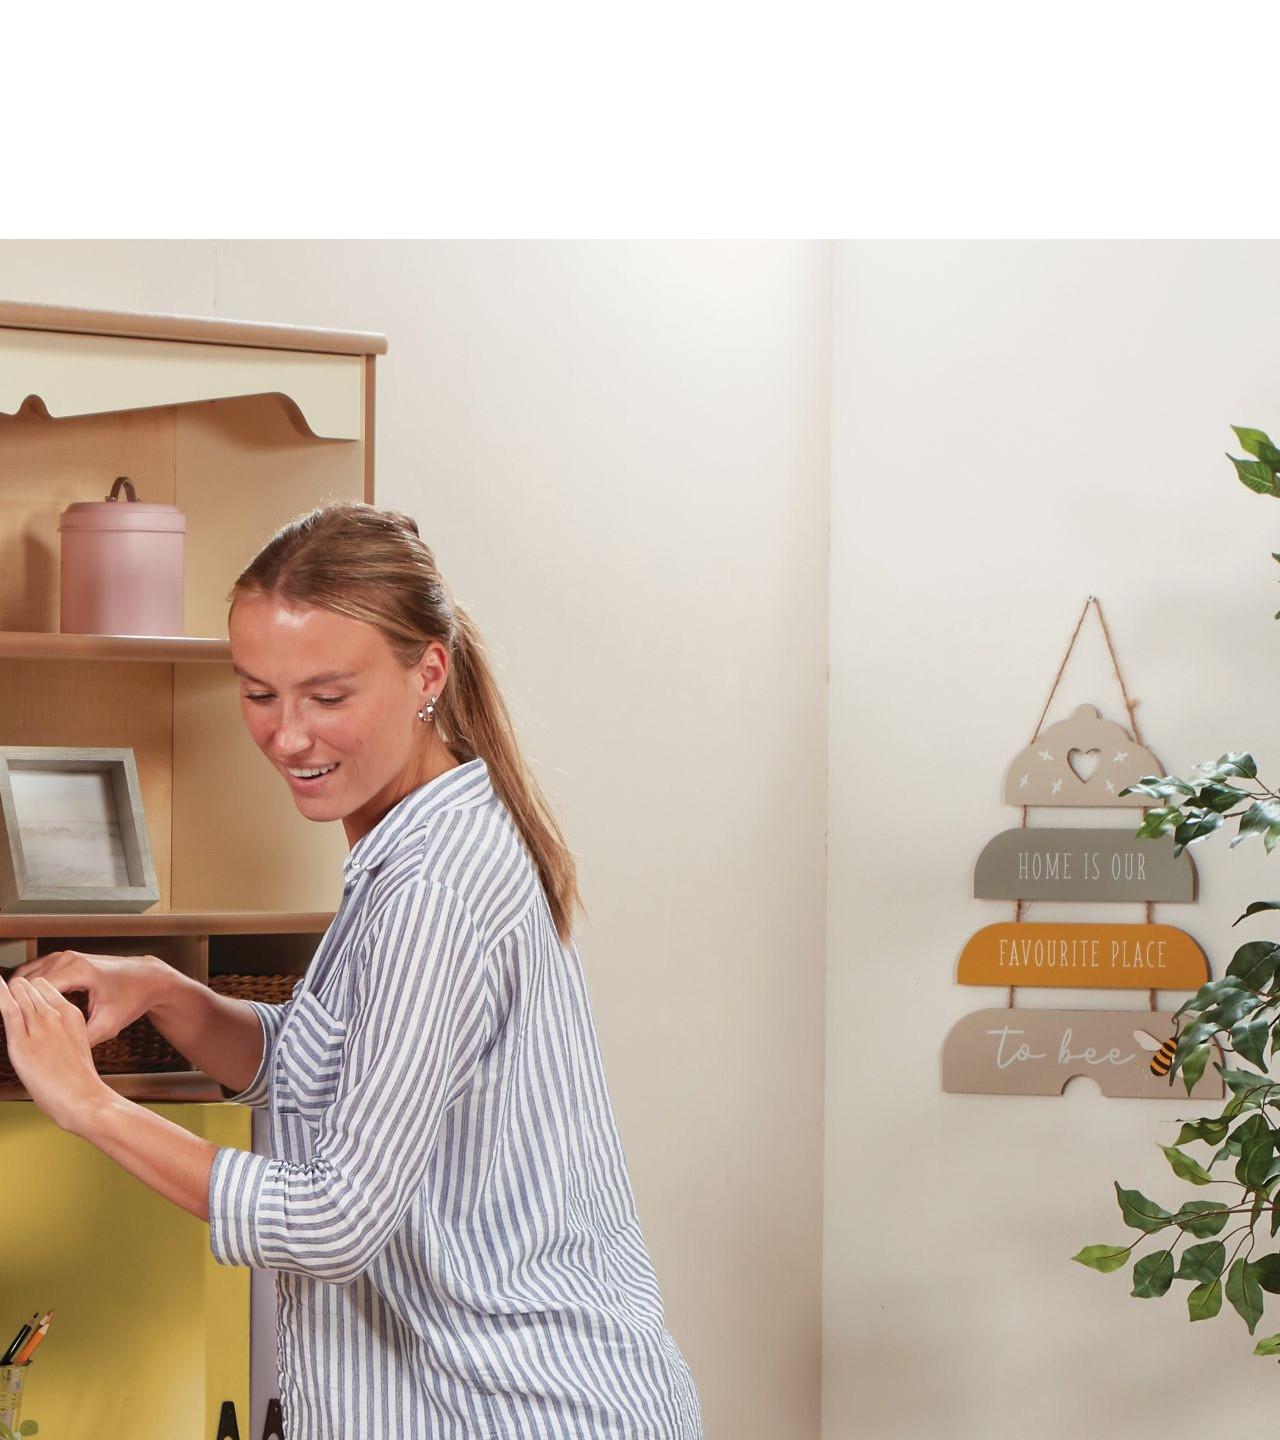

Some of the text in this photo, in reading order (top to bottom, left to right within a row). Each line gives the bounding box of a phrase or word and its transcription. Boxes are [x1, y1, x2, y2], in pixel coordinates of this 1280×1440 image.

[1017, 851, 1148, 881] HOME IS OUR
[998, 938, 1168, 969] FAVOURITE PLACE
[985, 1025, 1136, 1070] to bee
